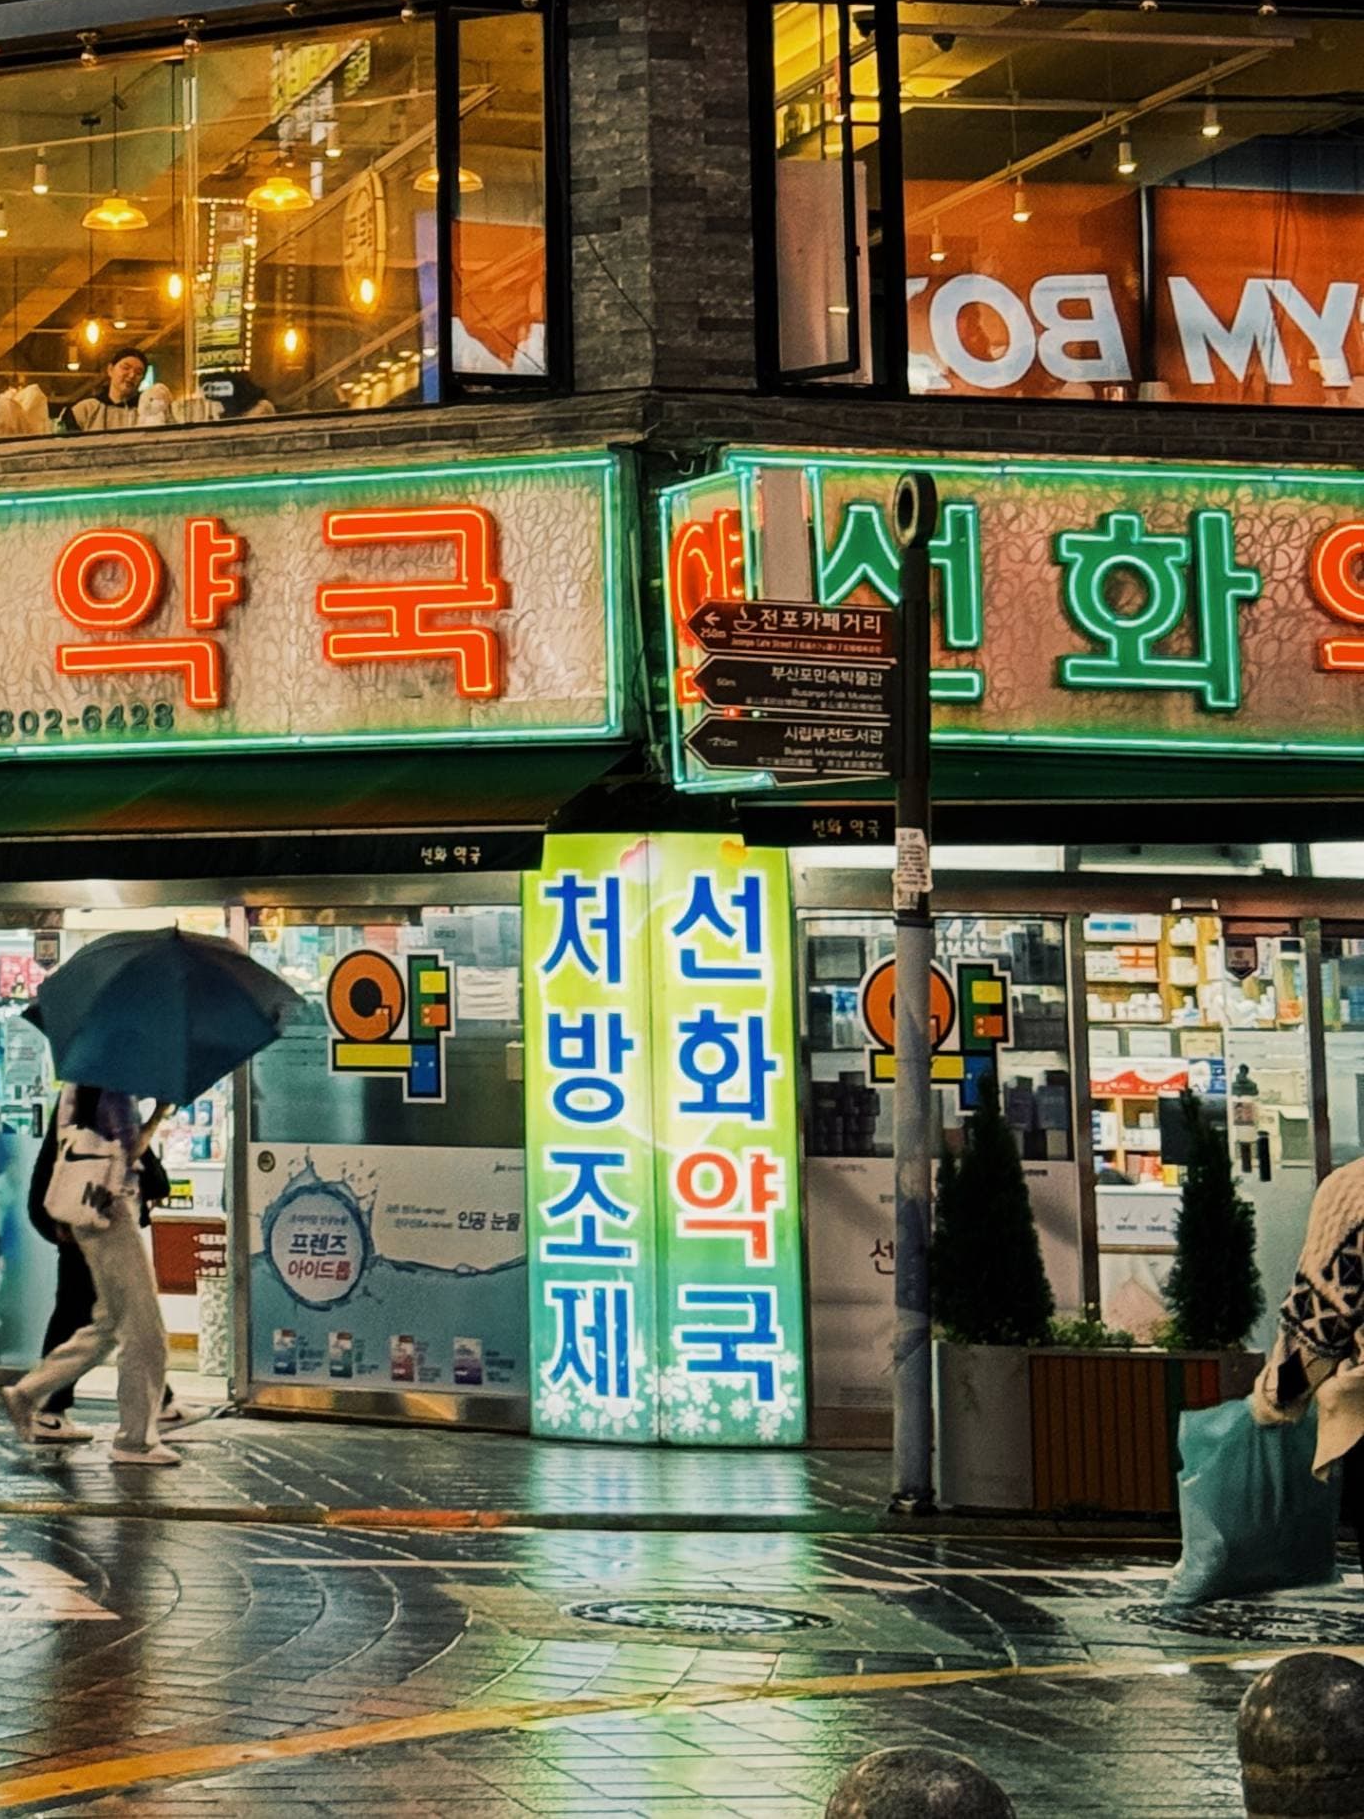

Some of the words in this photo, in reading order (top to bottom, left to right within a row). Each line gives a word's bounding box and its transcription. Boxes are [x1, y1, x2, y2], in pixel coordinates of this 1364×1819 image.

[52, 503, 509, 711] 약국
[760, 608, 882, 635] 전포카페거리
[848, 692, 883, 702] Museum
[785, 726, 883, 745] 시립부전도서관
[540, 873, 635, 1400] 처방조제
[670, 874, 780, 1403] 선화약국
[457, 1210, 487, 1231] 인공
[490, 1212, 521, 1232] 눈물
[288, 1232, 348, 1257] 프렌즈
